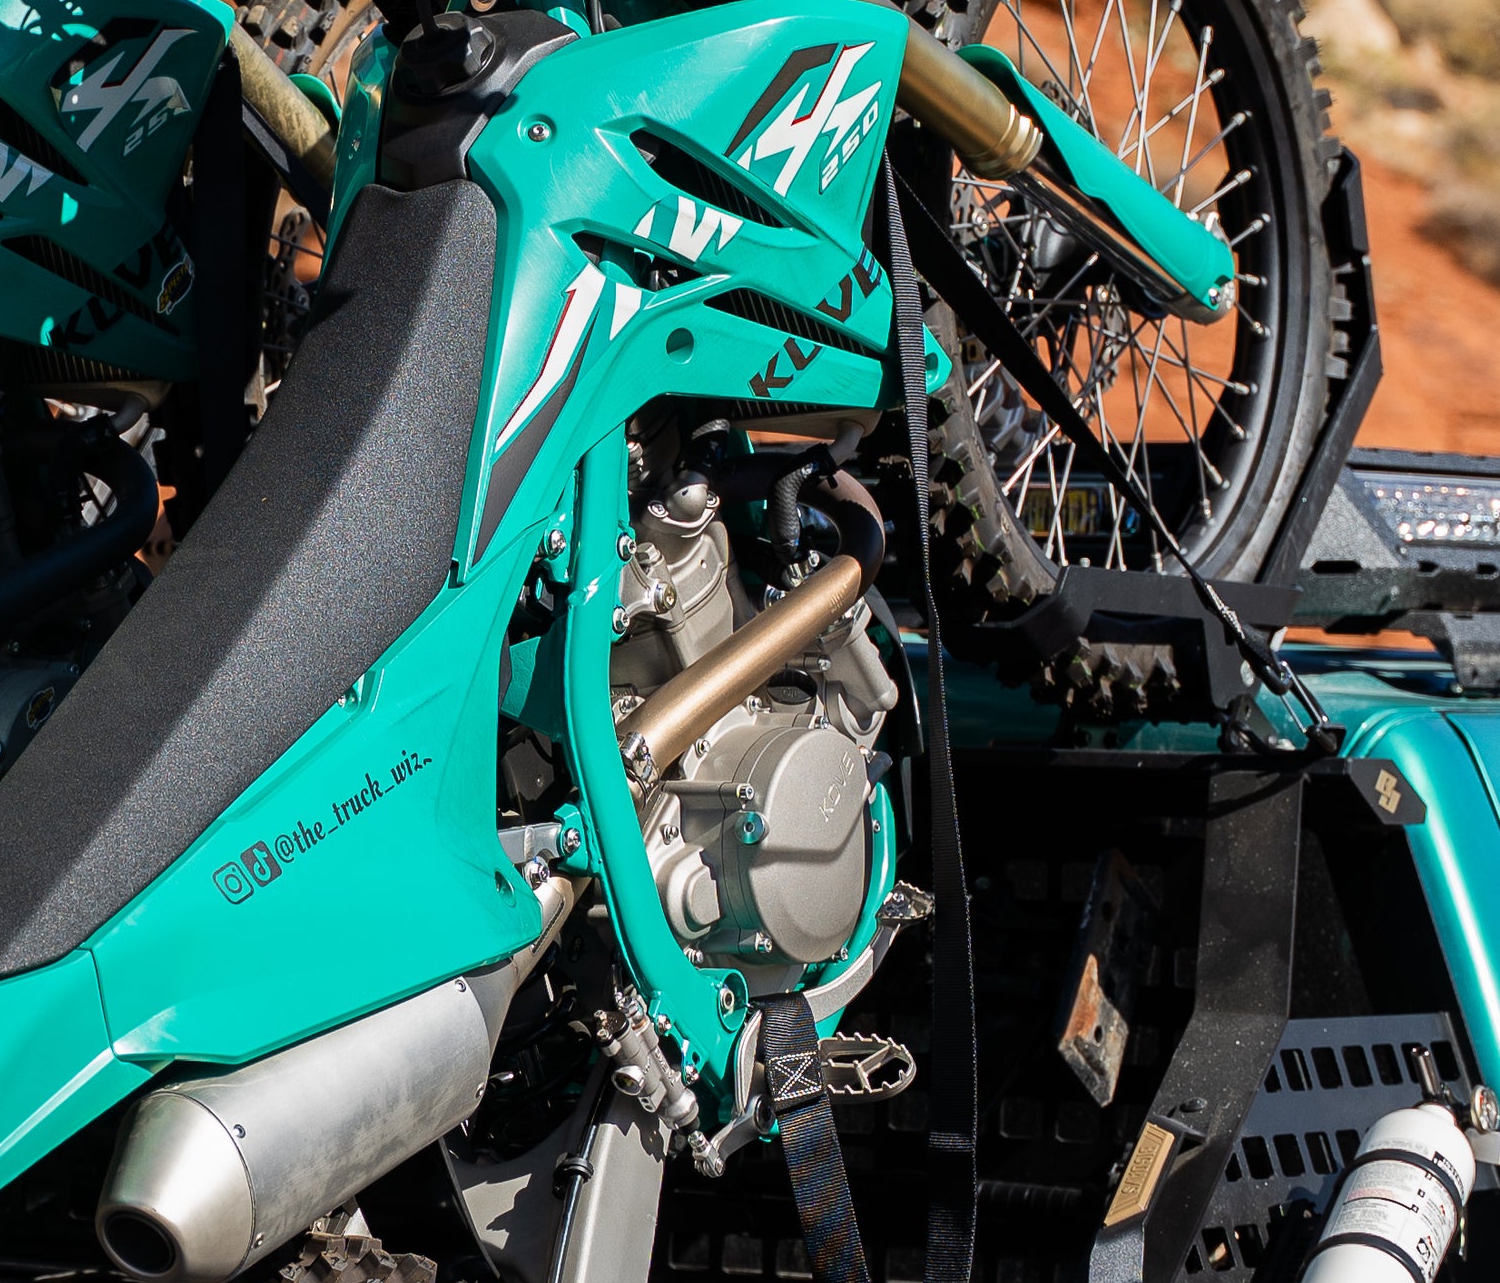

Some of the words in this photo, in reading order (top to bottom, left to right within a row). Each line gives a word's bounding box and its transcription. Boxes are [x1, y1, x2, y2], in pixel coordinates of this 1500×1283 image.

[123, 107, 168, 157] 25
[821, 101, 879, 191] 250
[818, 751, 855, 823] KOVE
